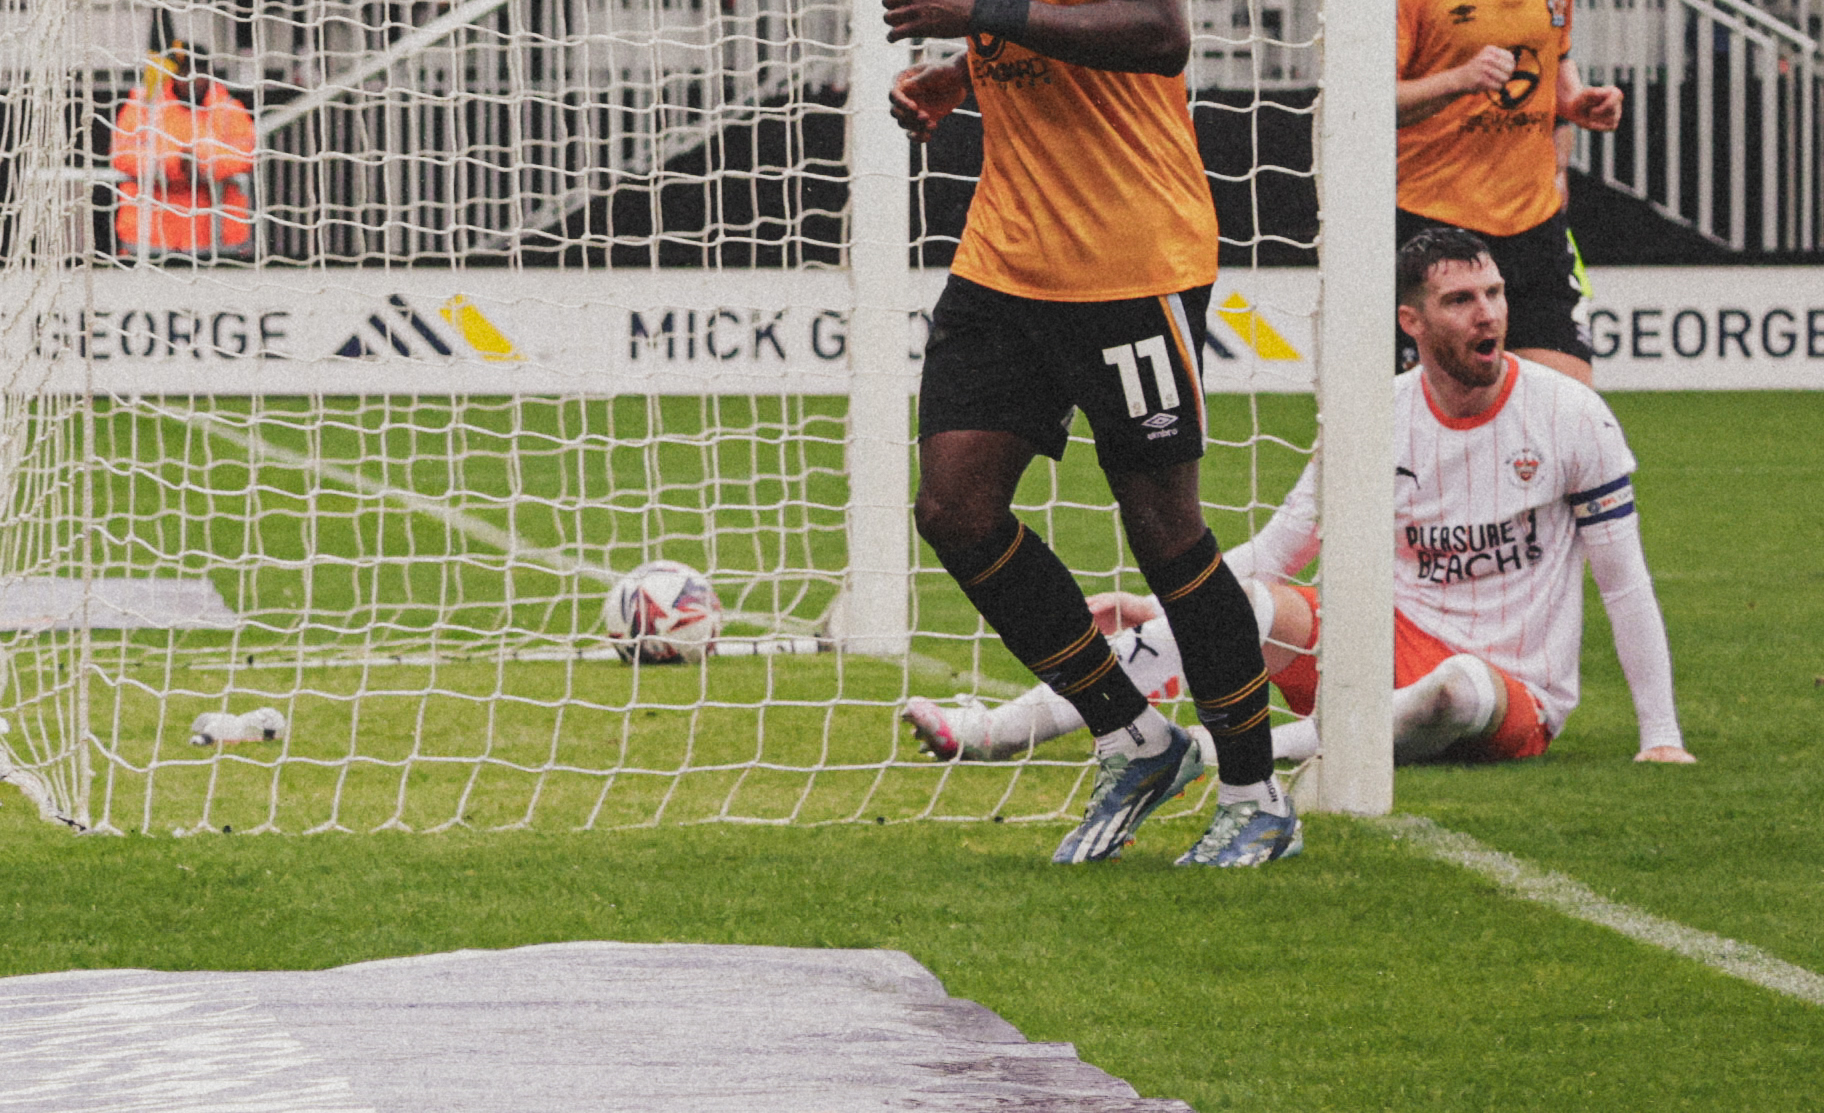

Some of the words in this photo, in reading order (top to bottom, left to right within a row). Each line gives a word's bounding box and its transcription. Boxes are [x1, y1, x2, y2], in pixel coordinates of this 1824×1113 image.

[630, 308, 786, 361] MICK
[1101, 334, 1181, 419] 11
[1405, 520, 1516, 553] PLEASURE
